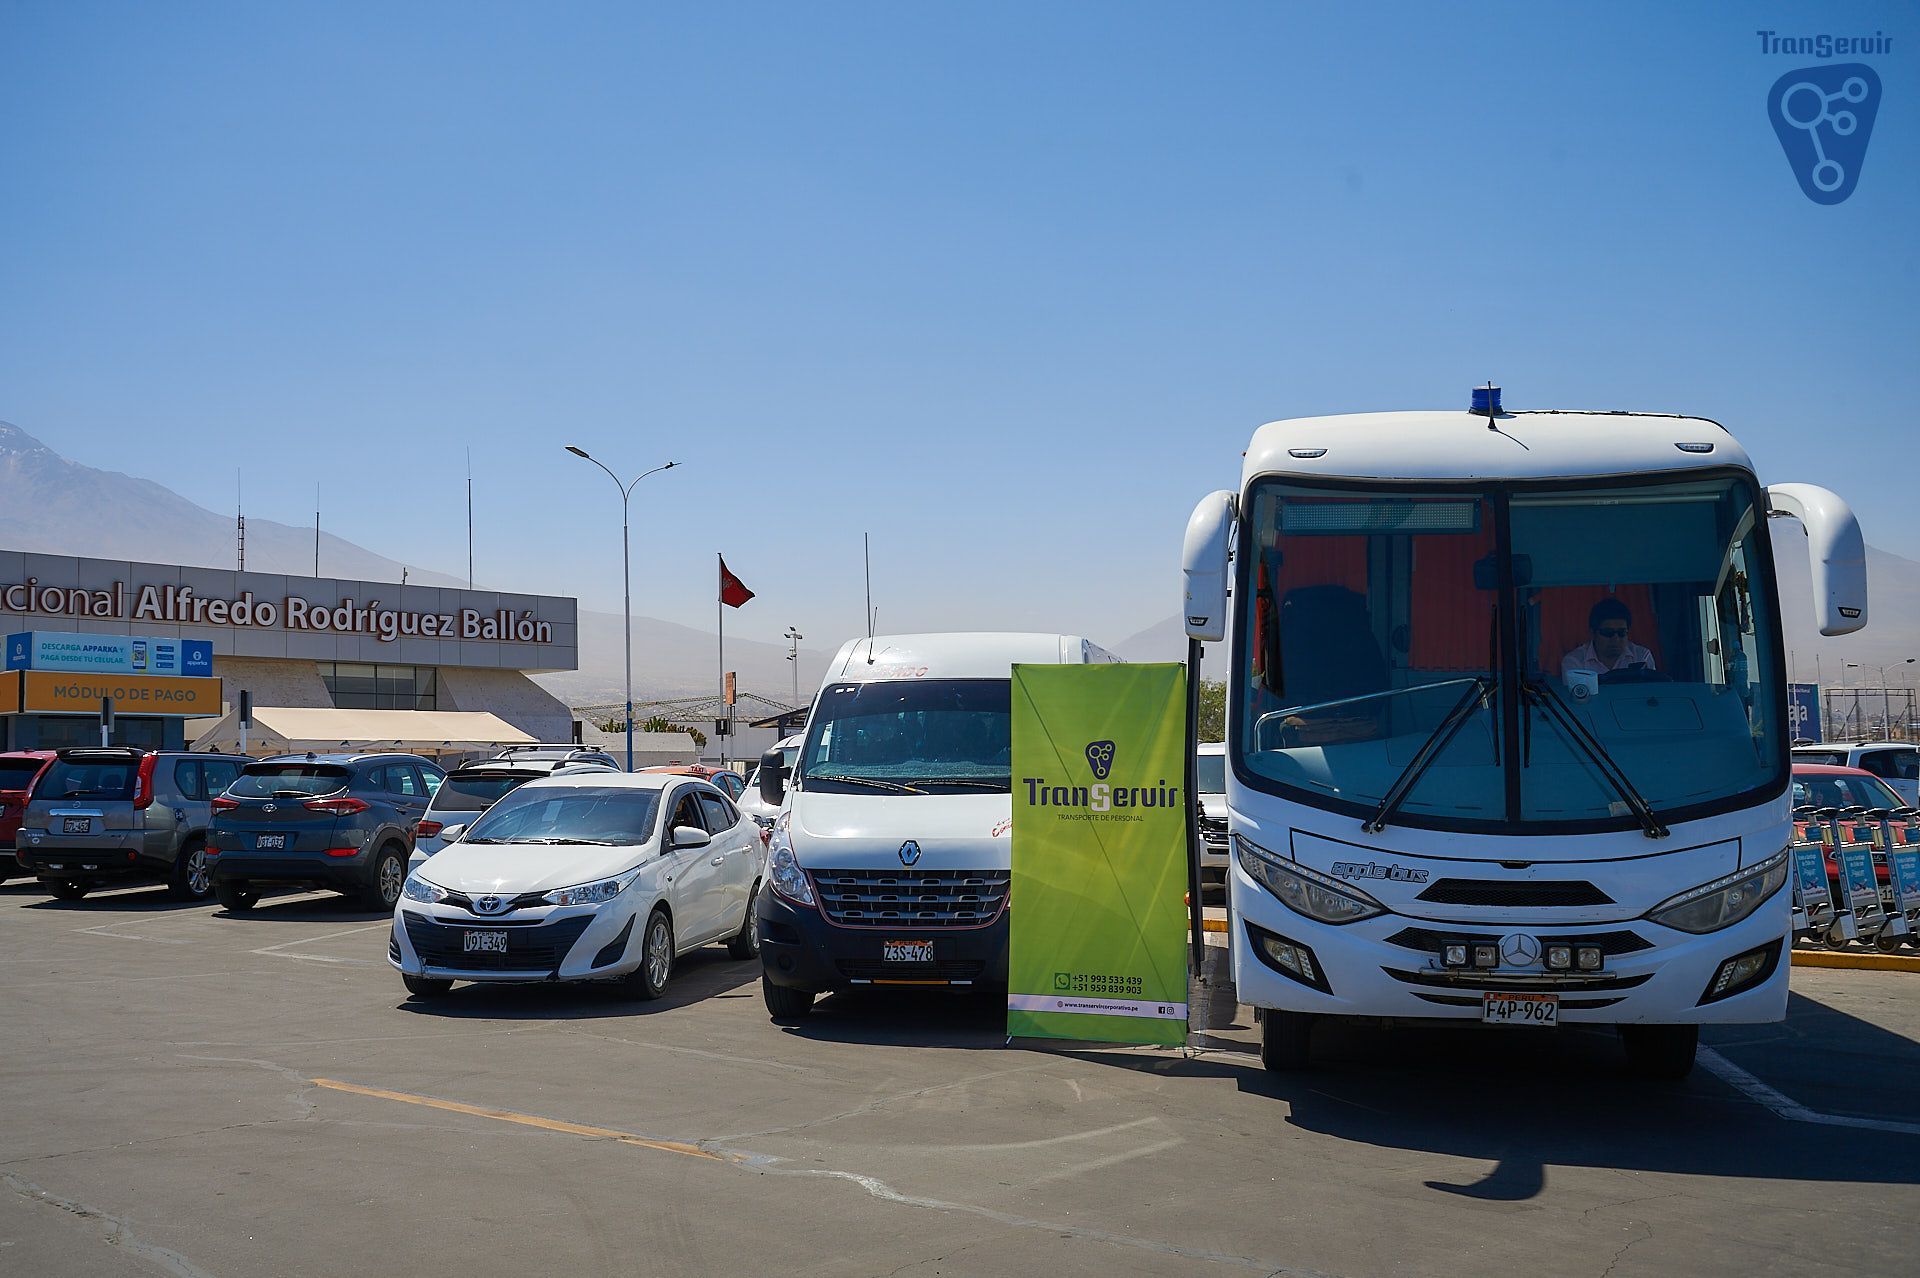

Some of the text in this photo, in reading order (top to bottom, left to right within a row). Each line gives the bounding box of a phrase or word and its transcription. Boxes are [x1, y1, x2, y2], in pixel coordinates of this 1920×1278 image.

[0, 577, 552, 643] cional Alfredo Rodríguez Ballón
[41, 642, 81, 652] DESCARGA
[82, 645, 118, 653] APPARKA
[54, 683, 197, 702] MÓDULO DE PAGO
[1057, 814, 1099, 822] TRANSPORTE
[1331, 861, 1430, 884] apple bus
[885, 945, 933, 961] Z3S-478
[1072, 974, 1142, 985] +51 993 533 439
[1072, 983, 1142, 995] +51 959 839 903
[1486, 1000, 1555, 1022] F4P-962
